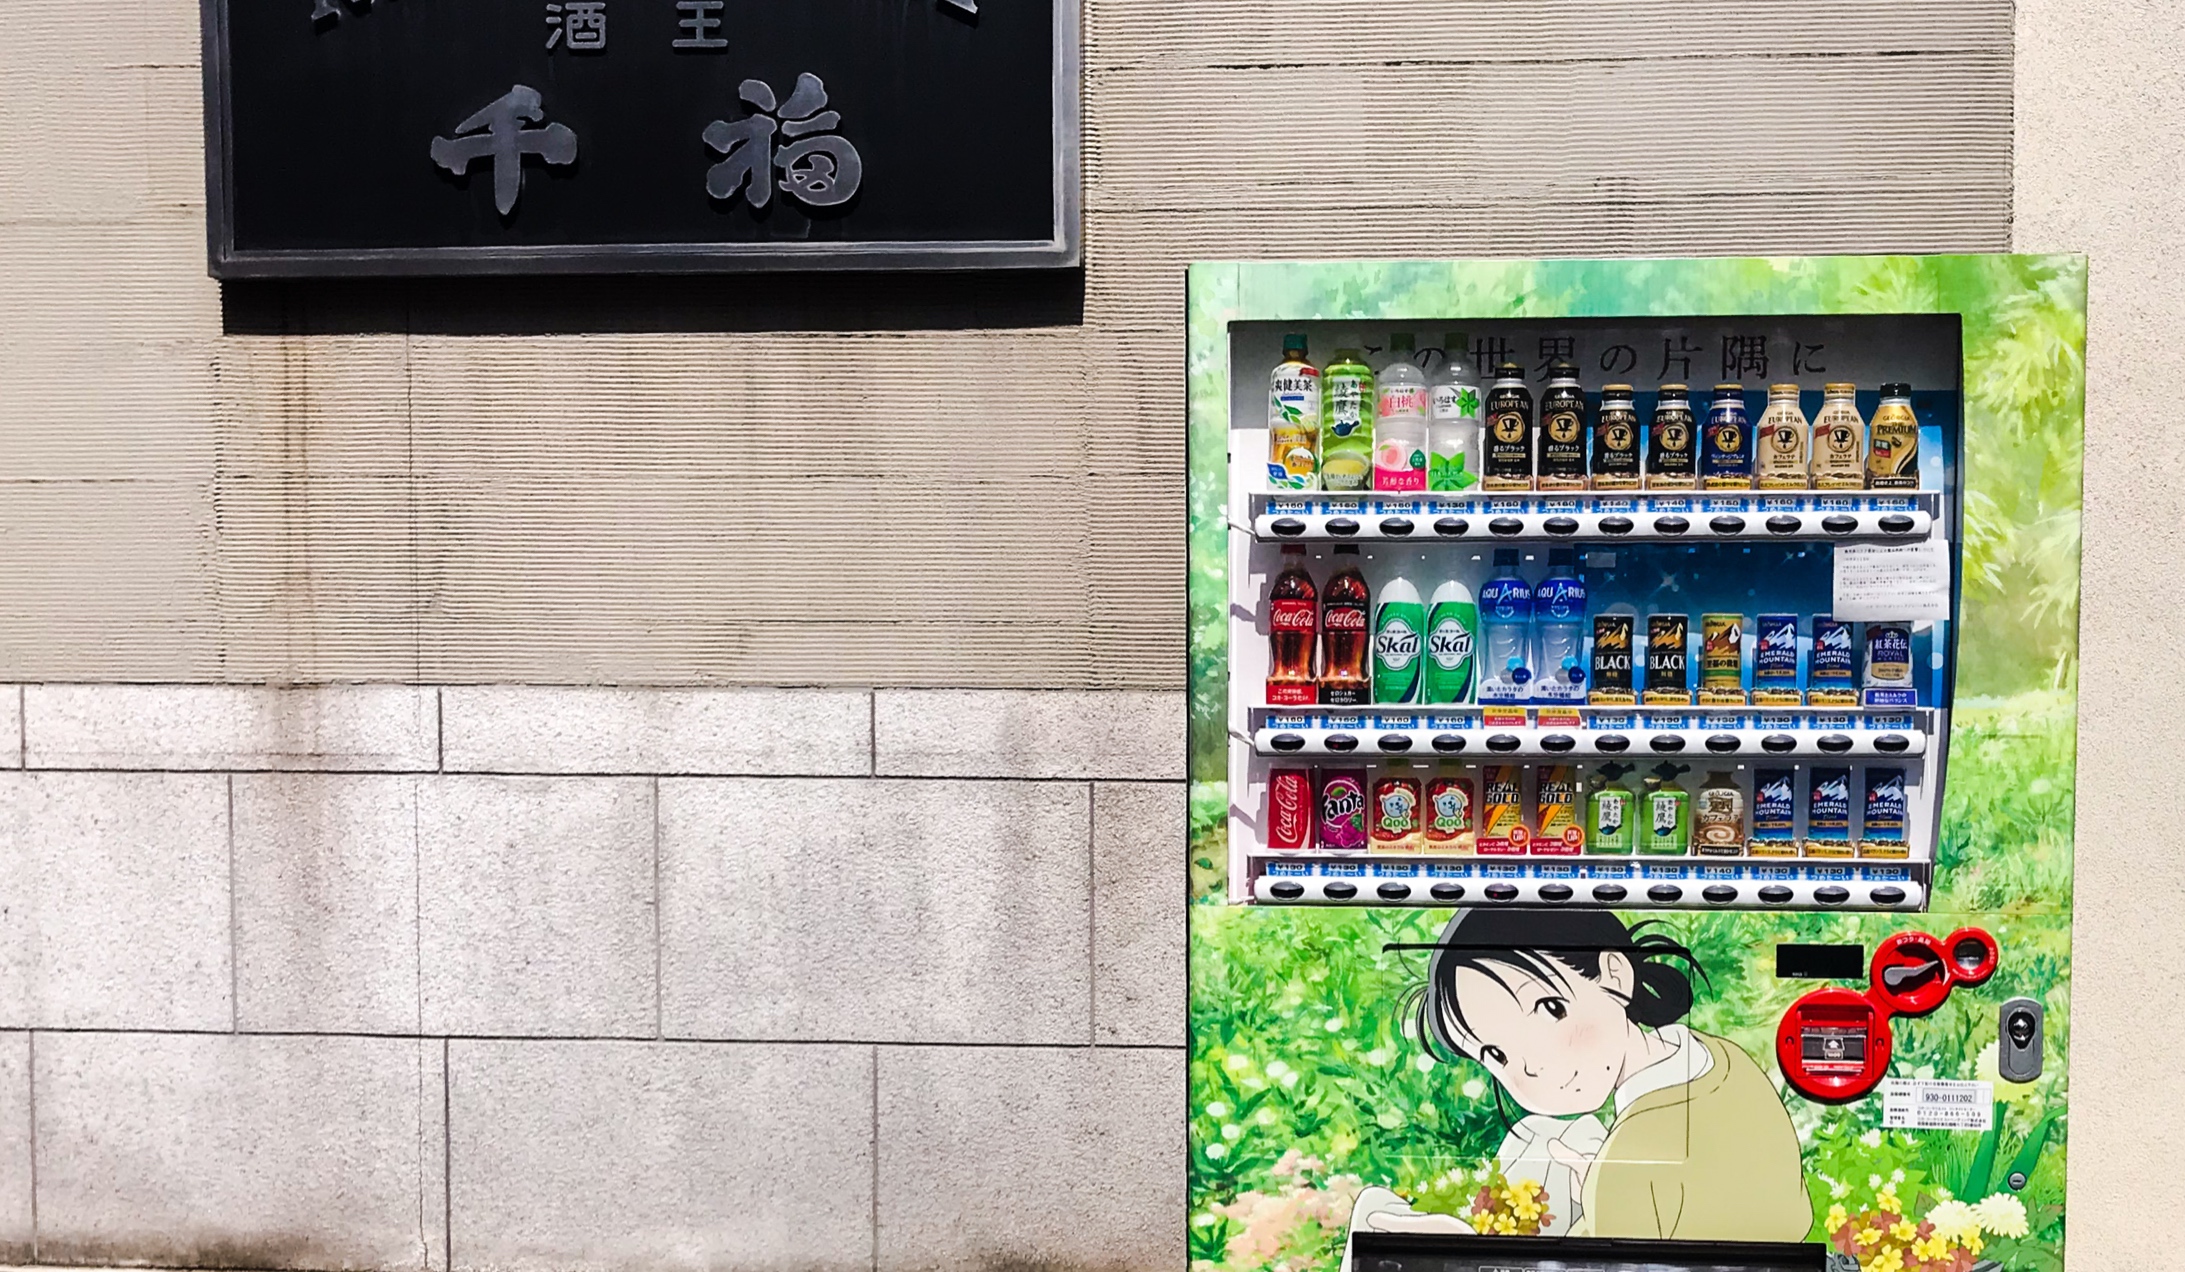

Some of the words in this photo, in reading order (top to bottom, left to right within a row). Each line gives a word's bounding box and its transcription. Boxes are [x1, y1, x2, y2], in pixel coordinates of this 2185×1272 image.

[1877, 424, 1917, 436] PREMIUM
[1482, 583, 1531, 605] AQUARIUS
[1537, 582, 1586, 605] AQUARIUS
[1272, 609, 1314, 627] Coca-Cola
[1324, 609, 1366, 628] Coca-Cola
[1874, 639, 1908, 650] 紅茶花伝
[1595, 655, 1631, 670] BLACK
[1650, 655, 1685, 670] BLACK
[1759, 656, 1795, 664] MOUNTAIN
[1486, 782, 1518, 792] REAL
[1540, 782, 1573, 792] REAL
[1486, 793, 1519, 804] GOLD
[1540, 793, 1572, 804] GOLD
[1275, 776, 1298, 843] Coca-Cola
[1866, 808, 1903, 816] MOUNTAIN
[1383, 817, 1409, 828] Qoo
[1436, 817, 1462, 827] Qoo
[1925, 1092, 1973, 1103] 930-0111202
